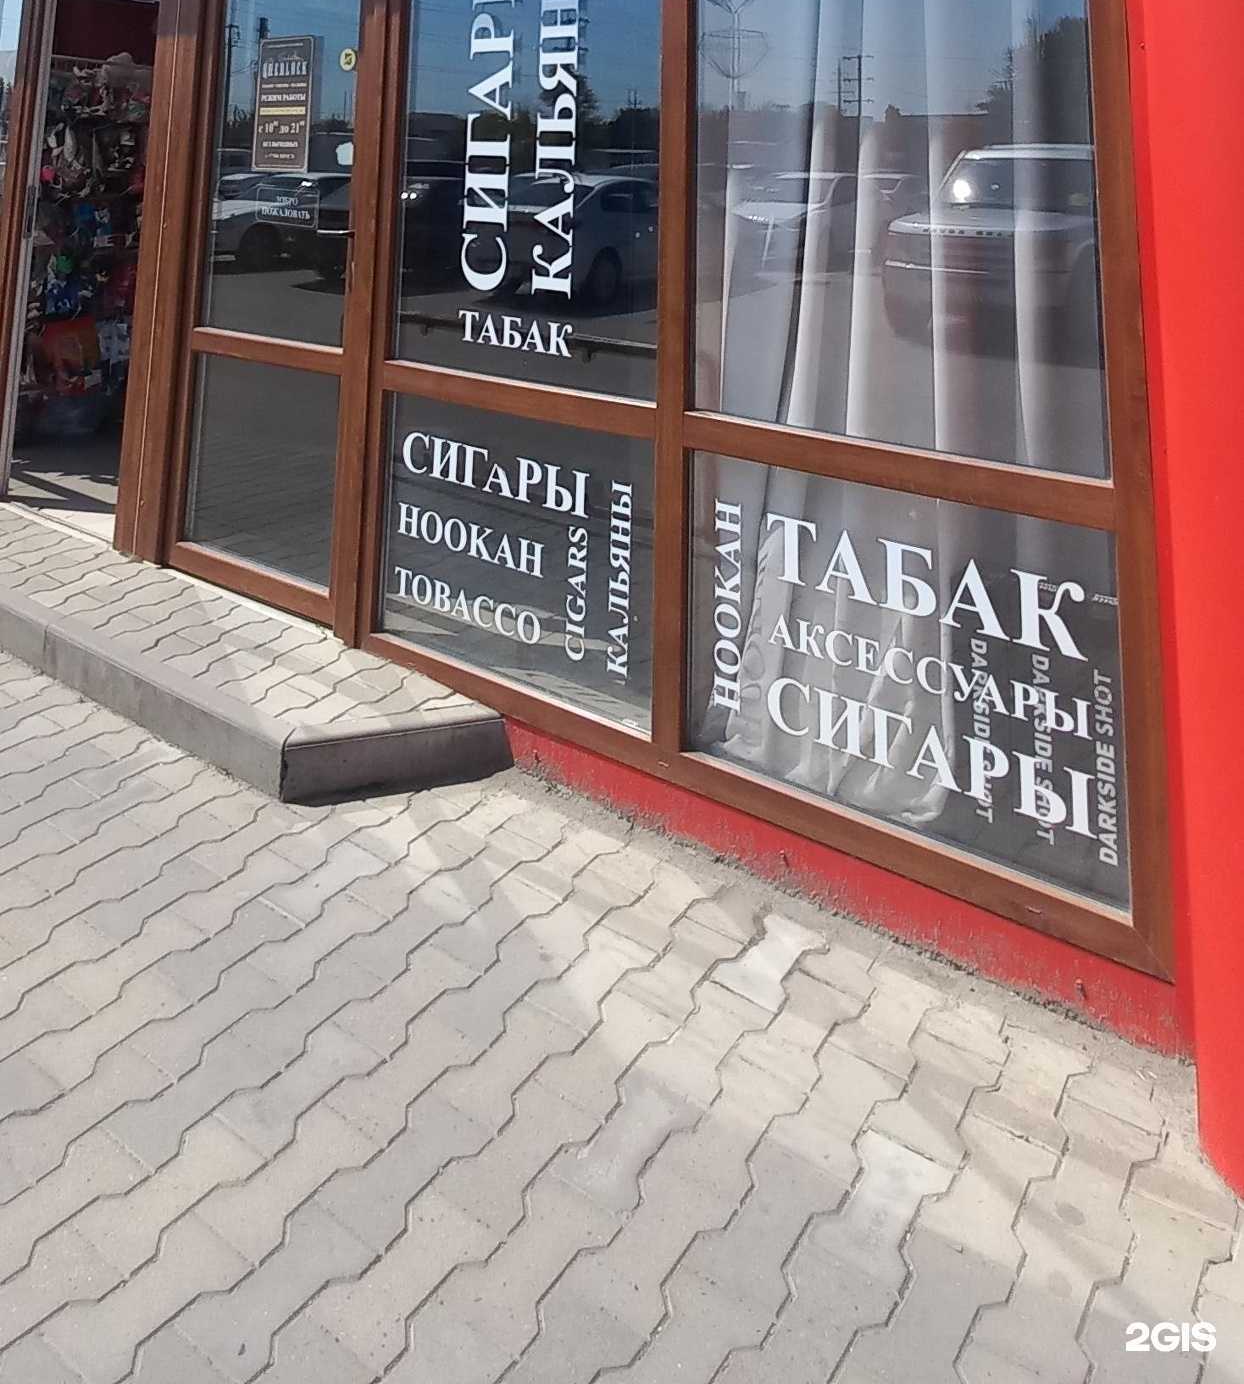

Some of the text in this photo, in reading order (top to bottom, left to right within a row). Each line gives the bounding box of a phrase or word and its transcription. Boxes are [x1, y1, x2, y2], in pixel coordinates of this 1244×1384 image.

[458, 310, 573, 358] ТАБАК
[394, 566, 542, 645] TOBACCO
[564, 525, 589, 662] CIGARS
[606, 480, 633, 680] КАЛЬЯНЫ
[765, 512, 1089, 662] ТАБАК
[767, 614, 1094, 741] АКСЕССУАРЫ
[766, 676, 1098, 839] СИГАРЫ
[1093, 668, 1119, 867] DARKSIDE SHOT
